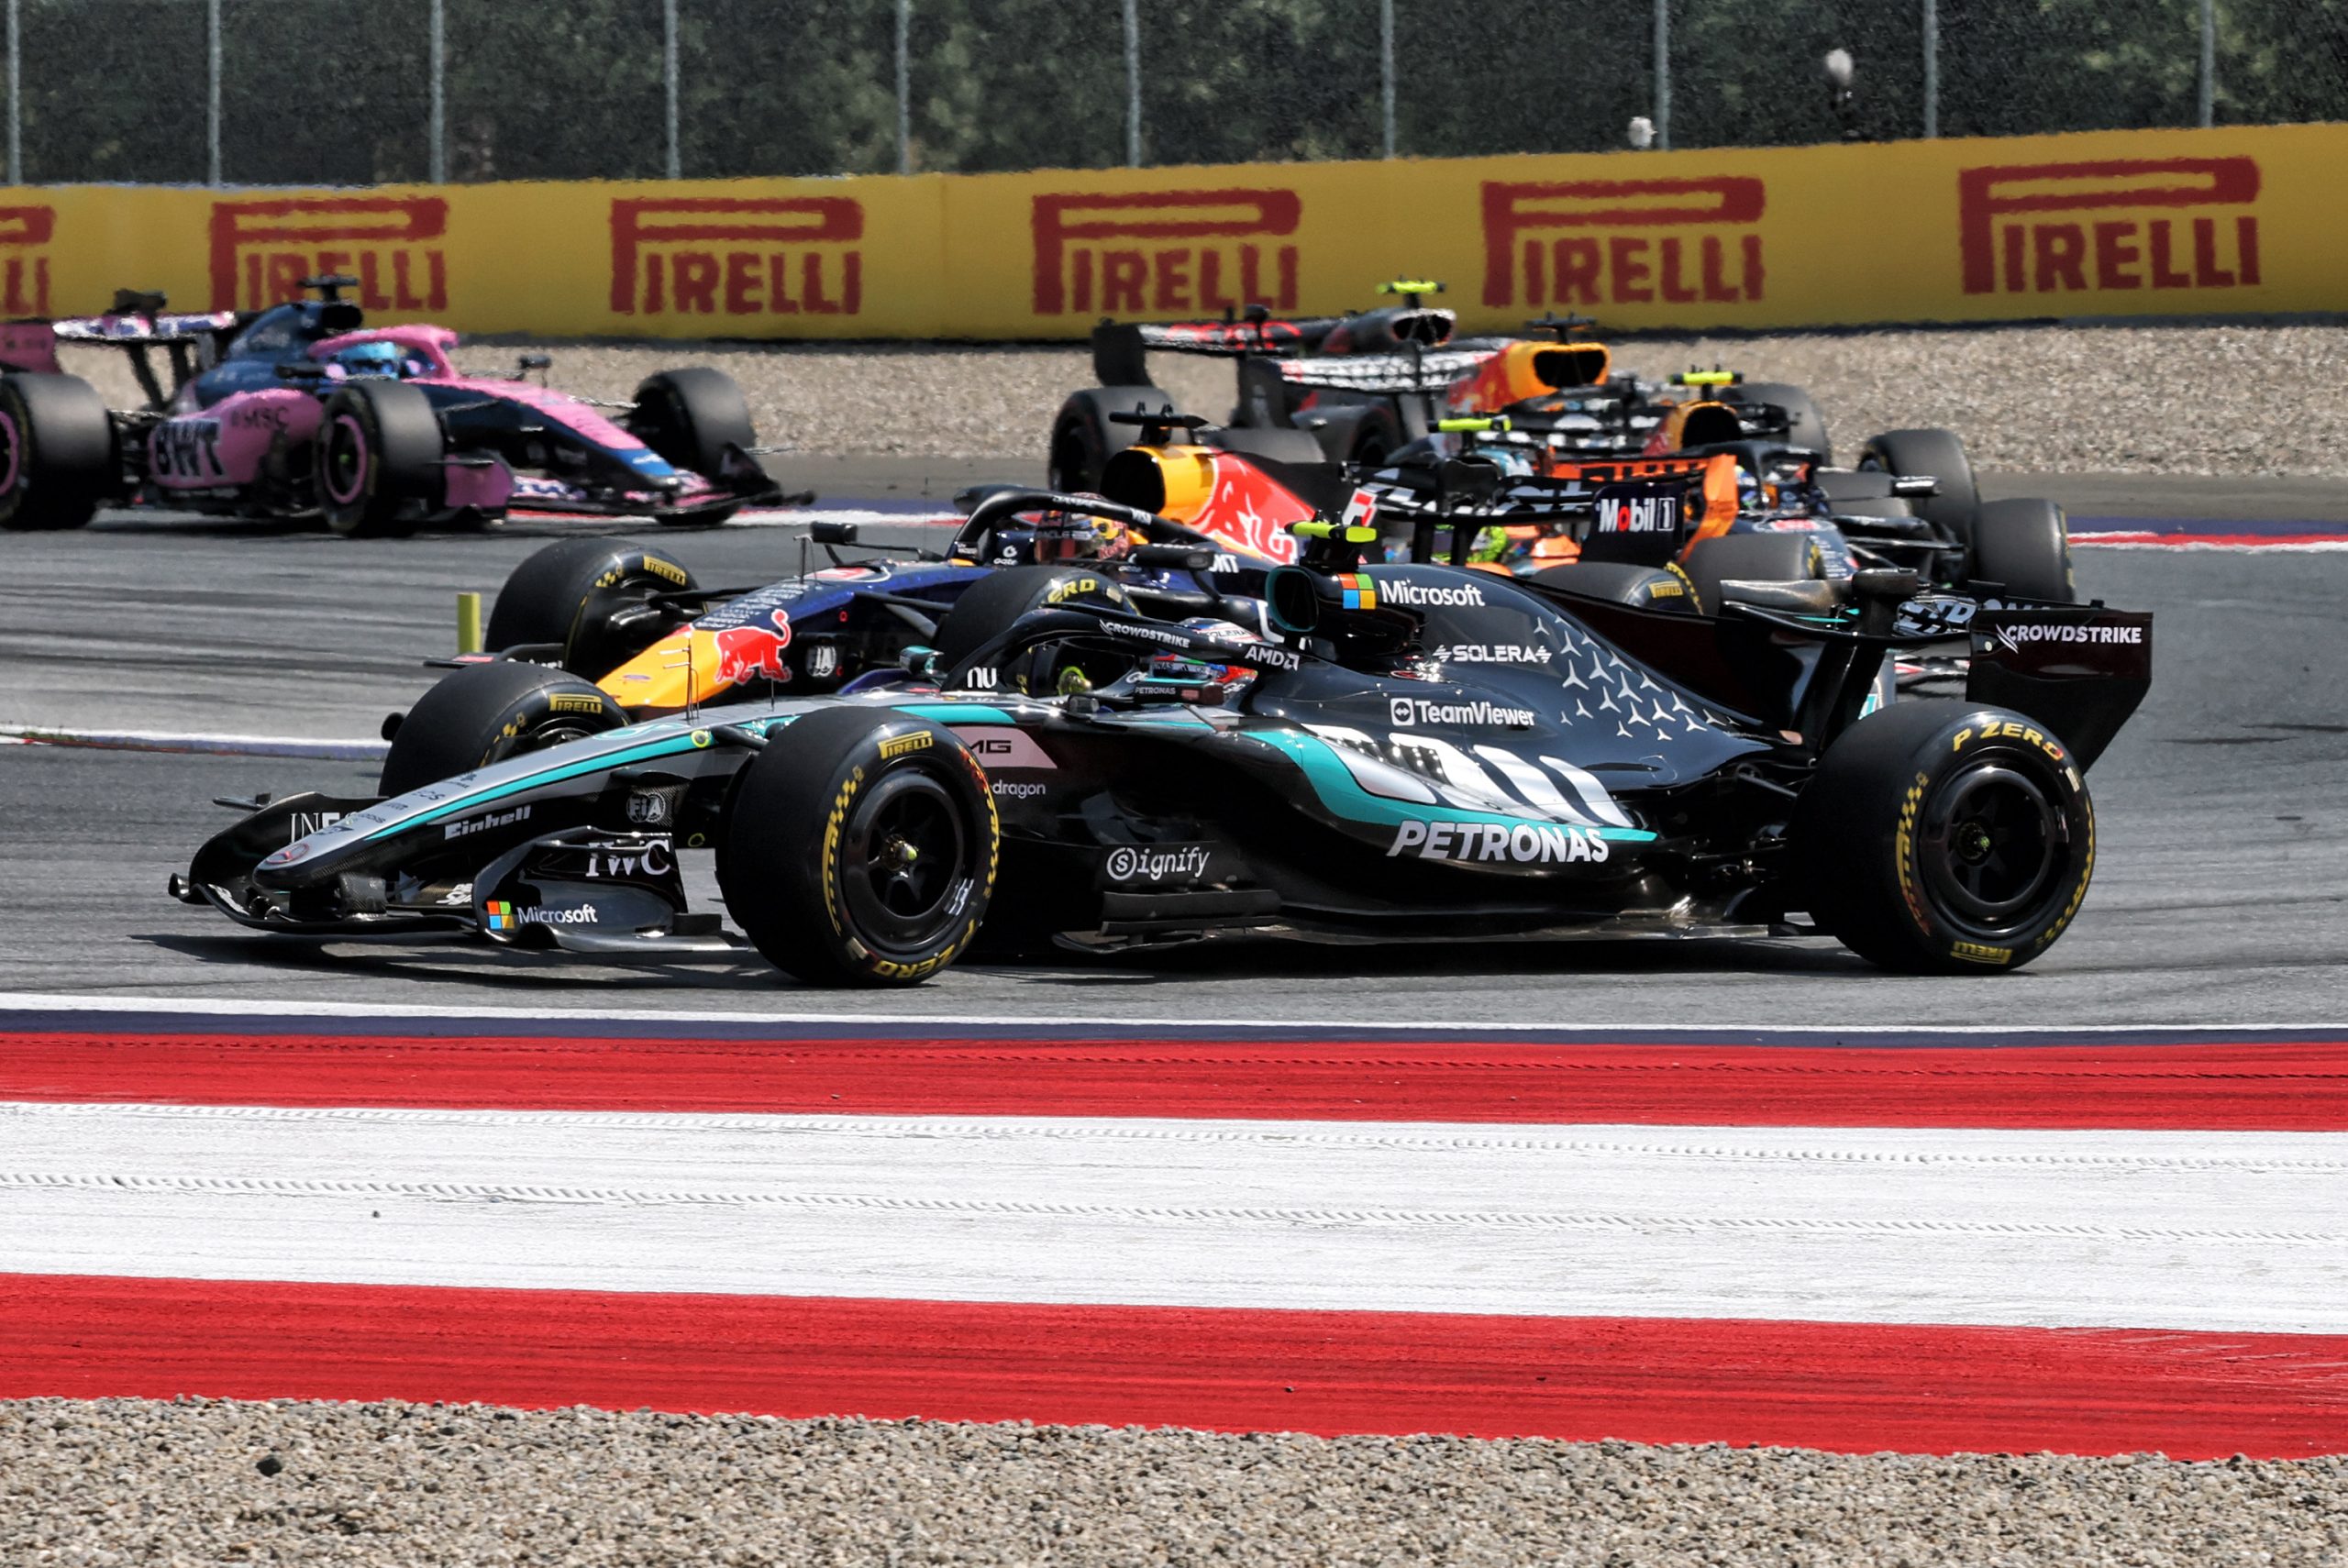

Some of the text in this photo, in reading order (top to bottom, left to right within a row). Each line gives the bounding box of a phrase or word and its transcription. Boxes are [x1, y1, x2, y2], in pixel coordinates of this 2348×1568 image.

[1959, 155, 2260, 294] PIRELLI
[210, 196, 449, 314] PIRELLI
[610, 196, 864, 315] PIRELLI
[1032, 188, 1301, 315] PIRELLI
[1481, 176, 1766, 308] PIRELLI
[155, 418, 224, 476] BWT
[1597, 498, 1656, 532] Mobil
[644, 556, 686, 586] PIRELLI
[1379, 579, 1485, 607] Microsoft
[1104, 623, 1191, 648] CROWDSTRIKE
[2006, 624, 2143, 644] CROWDSTRIKE
[1245, 645, 1284, 668] AMD
[1452, 645, 1535, 663] SOLERA
[550, 693, 602, 713] PIRELLI
[1135, 687, 1176, 695] PETRONAS
[1415, 701, 1535, 727] TeamViewer
[878, 731, 933, 759] PIRELLI
[969, 739, 1012, 754] MG
[1953, 721, 2064, 761] P ZERO
[991, 778, 1046, 798] dragon
[628, 793, 662, 820] FIA
[444, 804, 531, 840] Einhell
[1387, 819, 1610, 864] PETRONAS
[585, 839, 671, 878] IWC
[516, 903, 598, 924] Microsoft
[872, 944, 956, 979] ZERO
